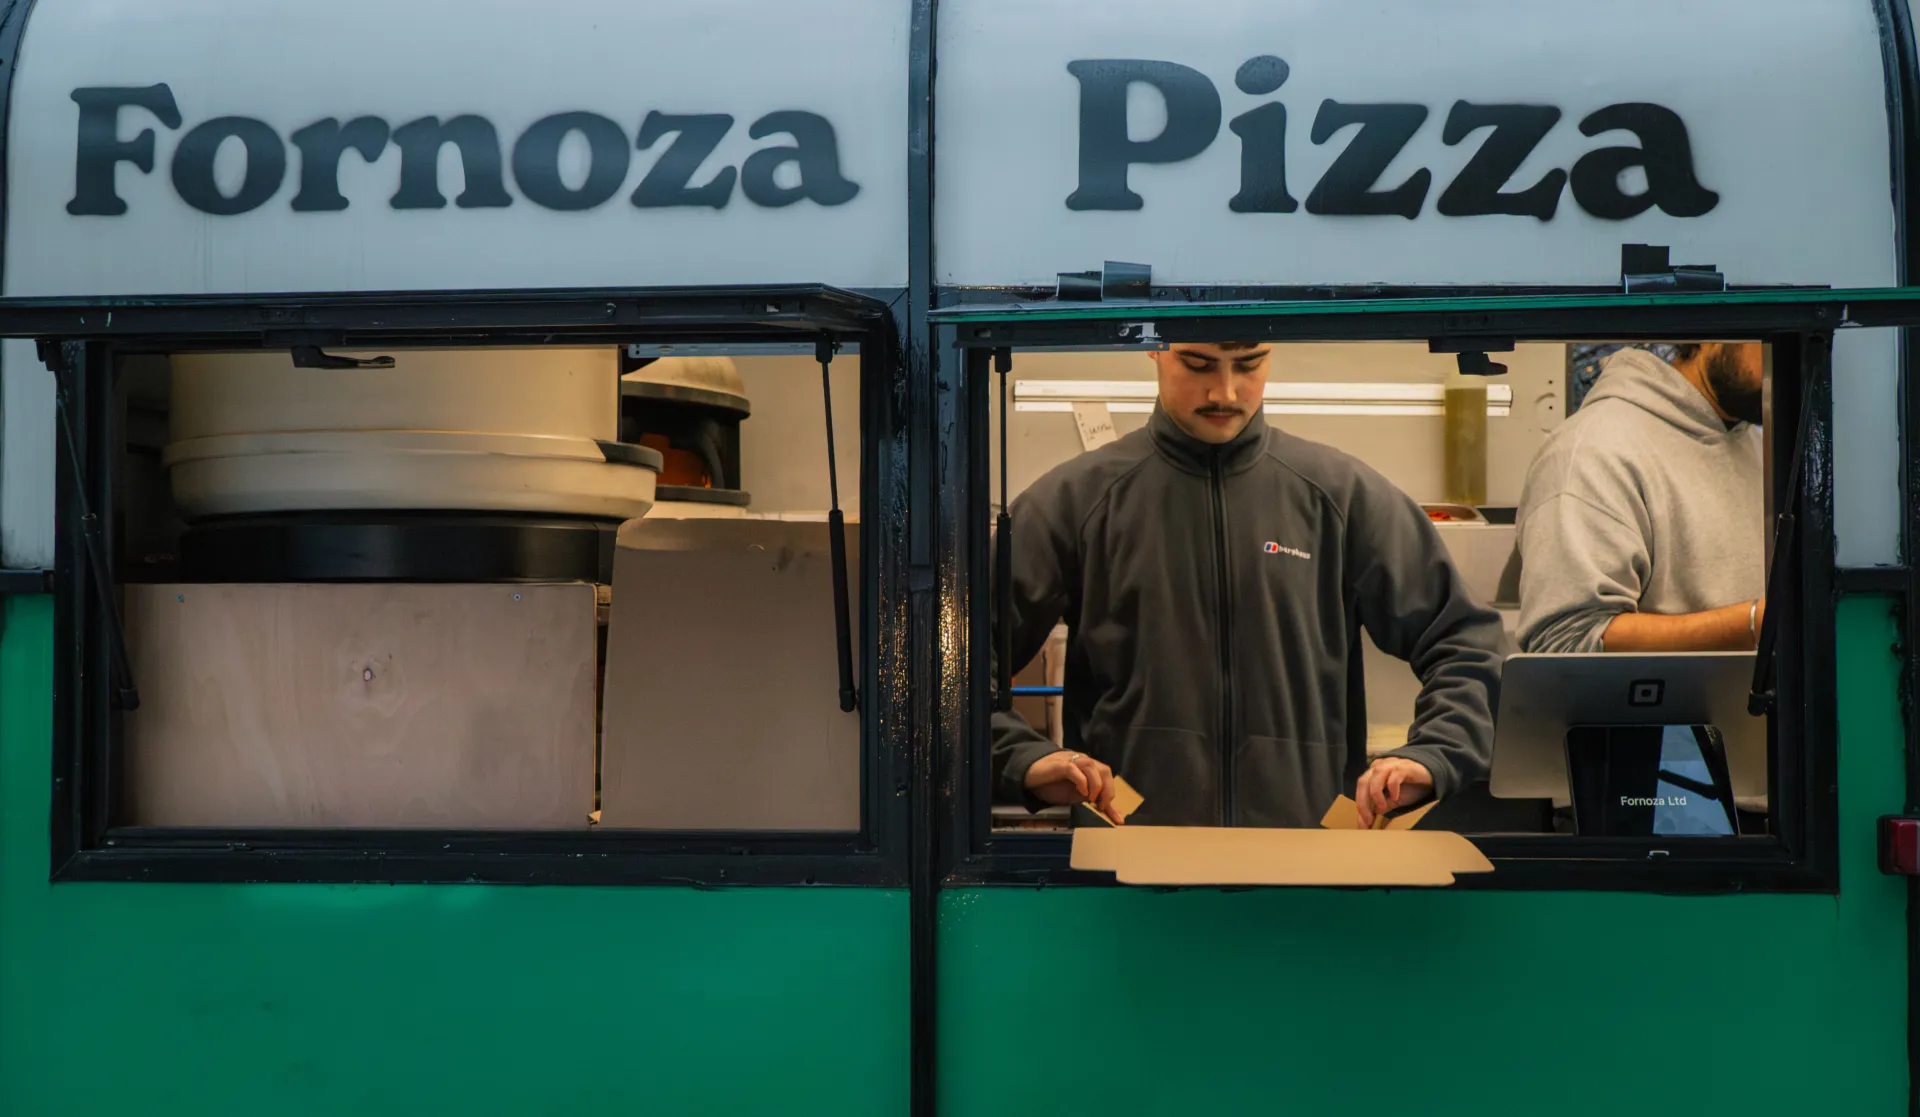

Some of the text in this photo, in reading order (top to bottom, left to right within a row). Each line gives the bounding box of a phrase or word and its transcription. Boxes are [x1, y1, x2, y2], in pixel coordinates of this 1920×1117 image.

[66, 82, 860, 216] Fornoza
[1065, 54, 1720, 221] Pizza
[1620, 796, 1687, 806] Fornoza Ltd
